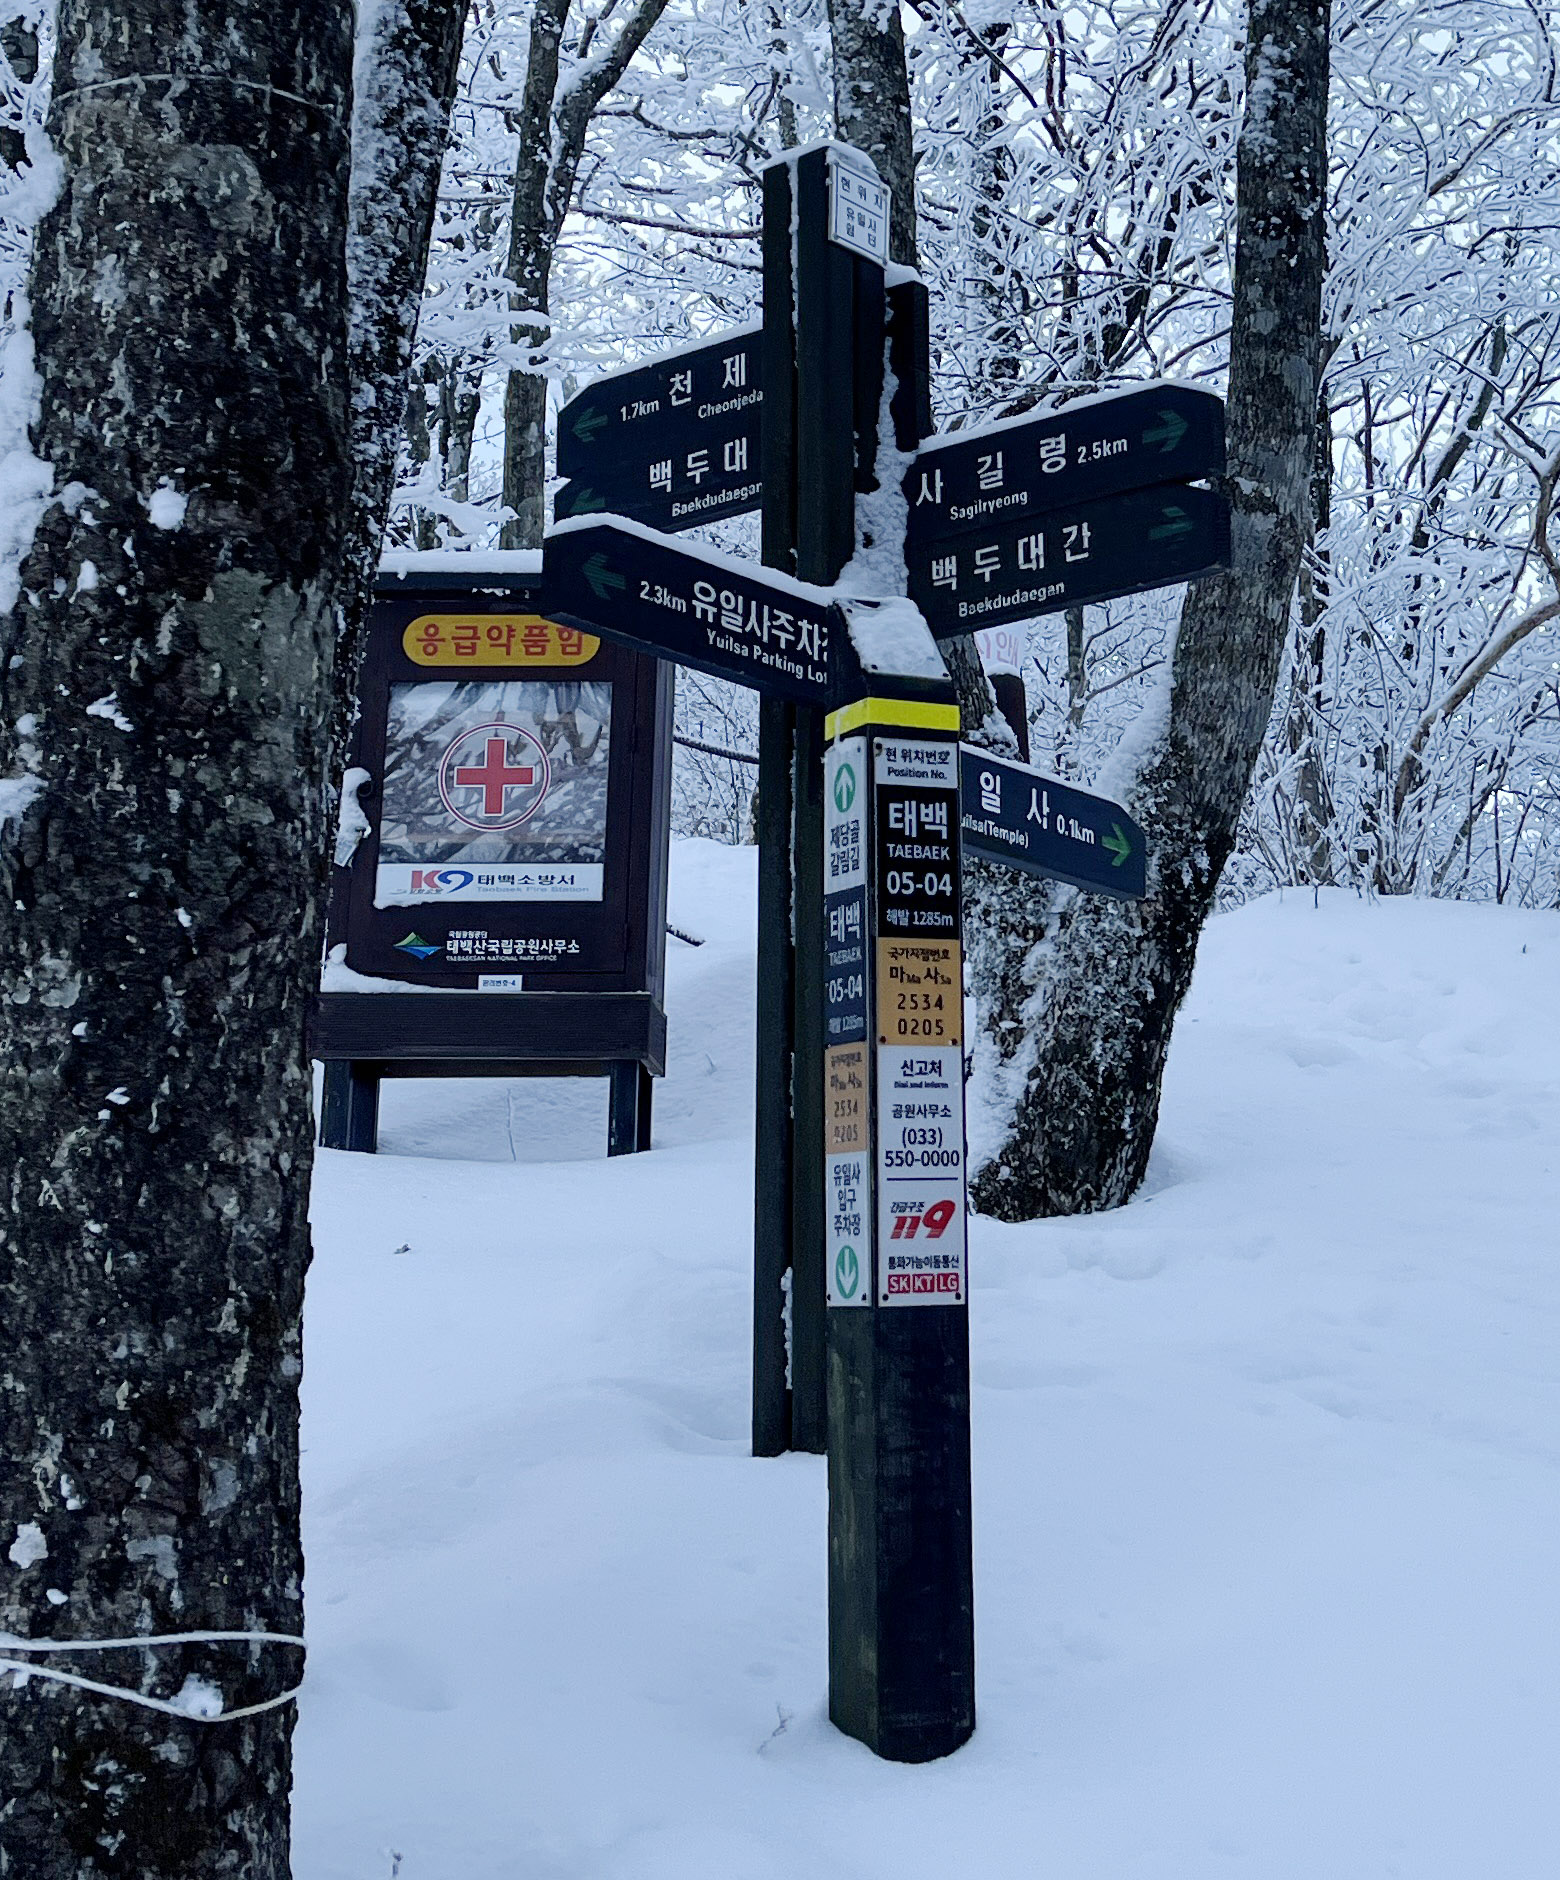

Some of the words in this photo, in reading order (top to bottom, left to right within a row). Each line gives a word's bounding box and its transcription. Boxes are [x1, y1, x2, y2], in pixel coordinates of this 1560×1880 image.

[620, 399, 660, 422] 1.7km
[698, 388, 764, 419] Cheonjeda
[1077, 437, 1128, 465] 2.5km
[950, 490, 1028, 521] Sagilryeong
[639, 580, 687, 613] 2.3km
[958, 581, 1066, 618] Baekdudaegan
[706, 627, 749, 657] Yuilsa
[753, 644, 804, 680] Parking
[887, 766, 929, 779] Position
[930, 769, 948, 780] No.
[889, 800, 948, 840] 태백
[1056, 813, 1096, 845] 0.1km
[886, 843, 950, 860] TAEBAEK
[477, 873, 575, 886] 태백소방서
[886, 870, 953, 897] 05-04
[830, 900, 861, 943] 태백
[912, 910, 954, 927] 1285m
[446, 939, 580, 955] 태백산국립공원사무소
[828, 973, 863, 1003] 05-04
[897, 993, 945, 1011] 2534
[897, 1018, 945, 1036] 0205
[900, 1058, 943, 1078] 신고처
[833, 1099, 859, 1118] 2534
[891, 1103, 952, 1119] 공원사무소
[901, 1126, 943, 1149] (033)
[884, 1149, 960, 1168] 550-0000
[833, 1161, 861, 1186] 유일사
[837, 1188, 857, 1212] 입구
[833, 1212, 861, 1237] 주차장
[889, 1199, 956, 1239] 119
[888, 1254, 960, 1270] 통화가능이동통신
[889, 1276, 910, 1292] SK
[914, 1275, 934, 1292] KT
[939, 1274, 958, 1291] LG
